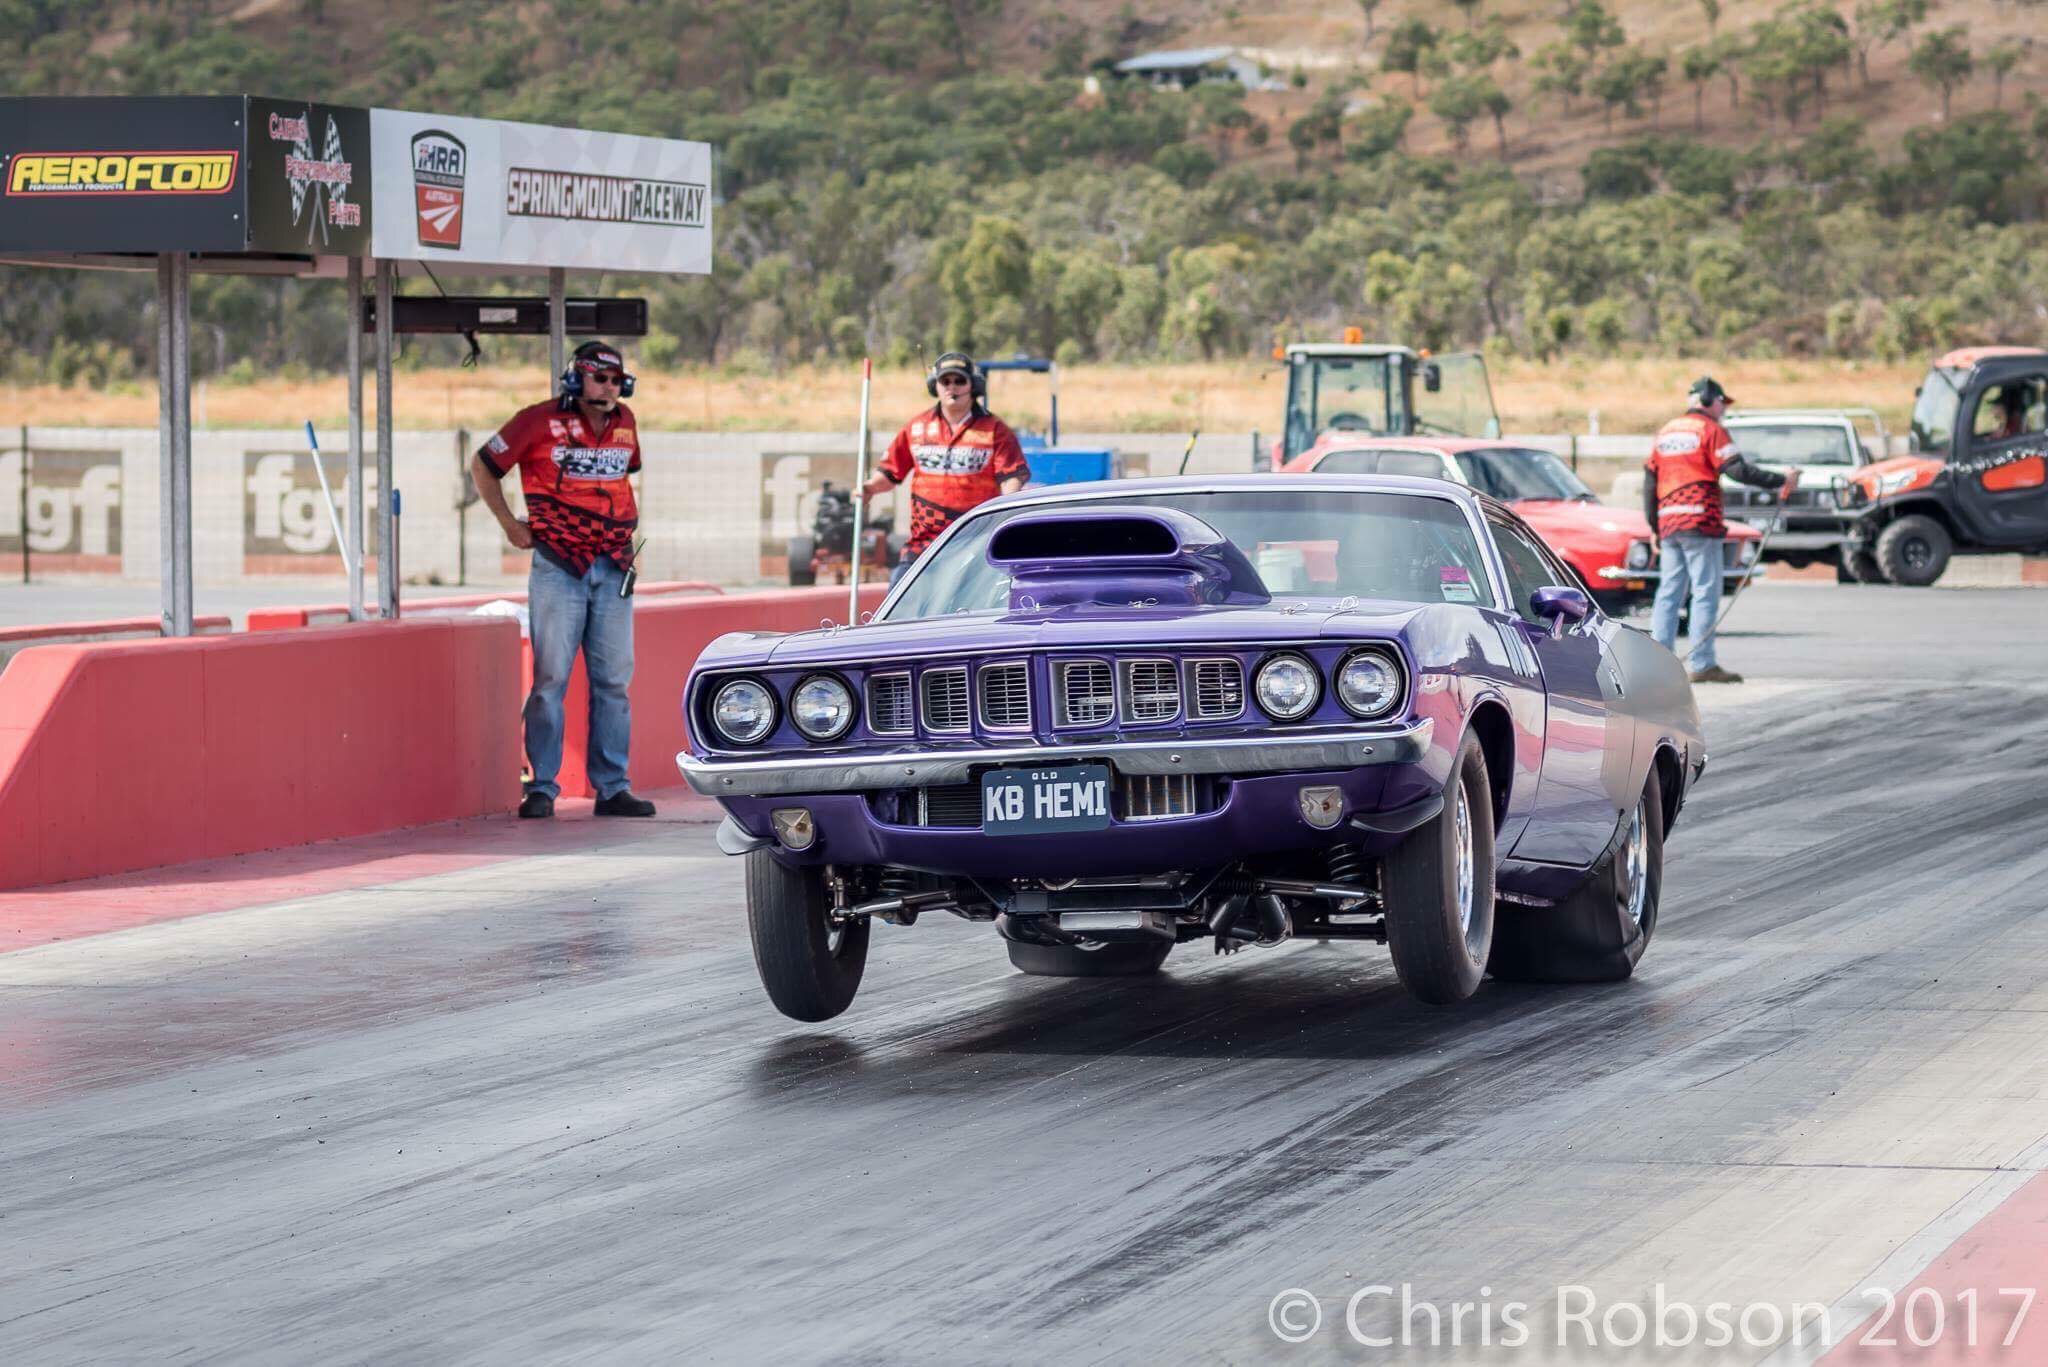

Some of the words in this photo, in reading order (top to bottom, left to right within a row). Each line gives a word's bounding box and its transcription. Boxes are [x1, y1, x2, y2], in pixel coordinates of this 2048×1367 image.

[12, 155, 233, 192] AEROFLOW
[1031, 771, 1058, 781] QLD
[985, 785, 1025, 822] KB
[1034, 780, 1107, 820] HEMI
